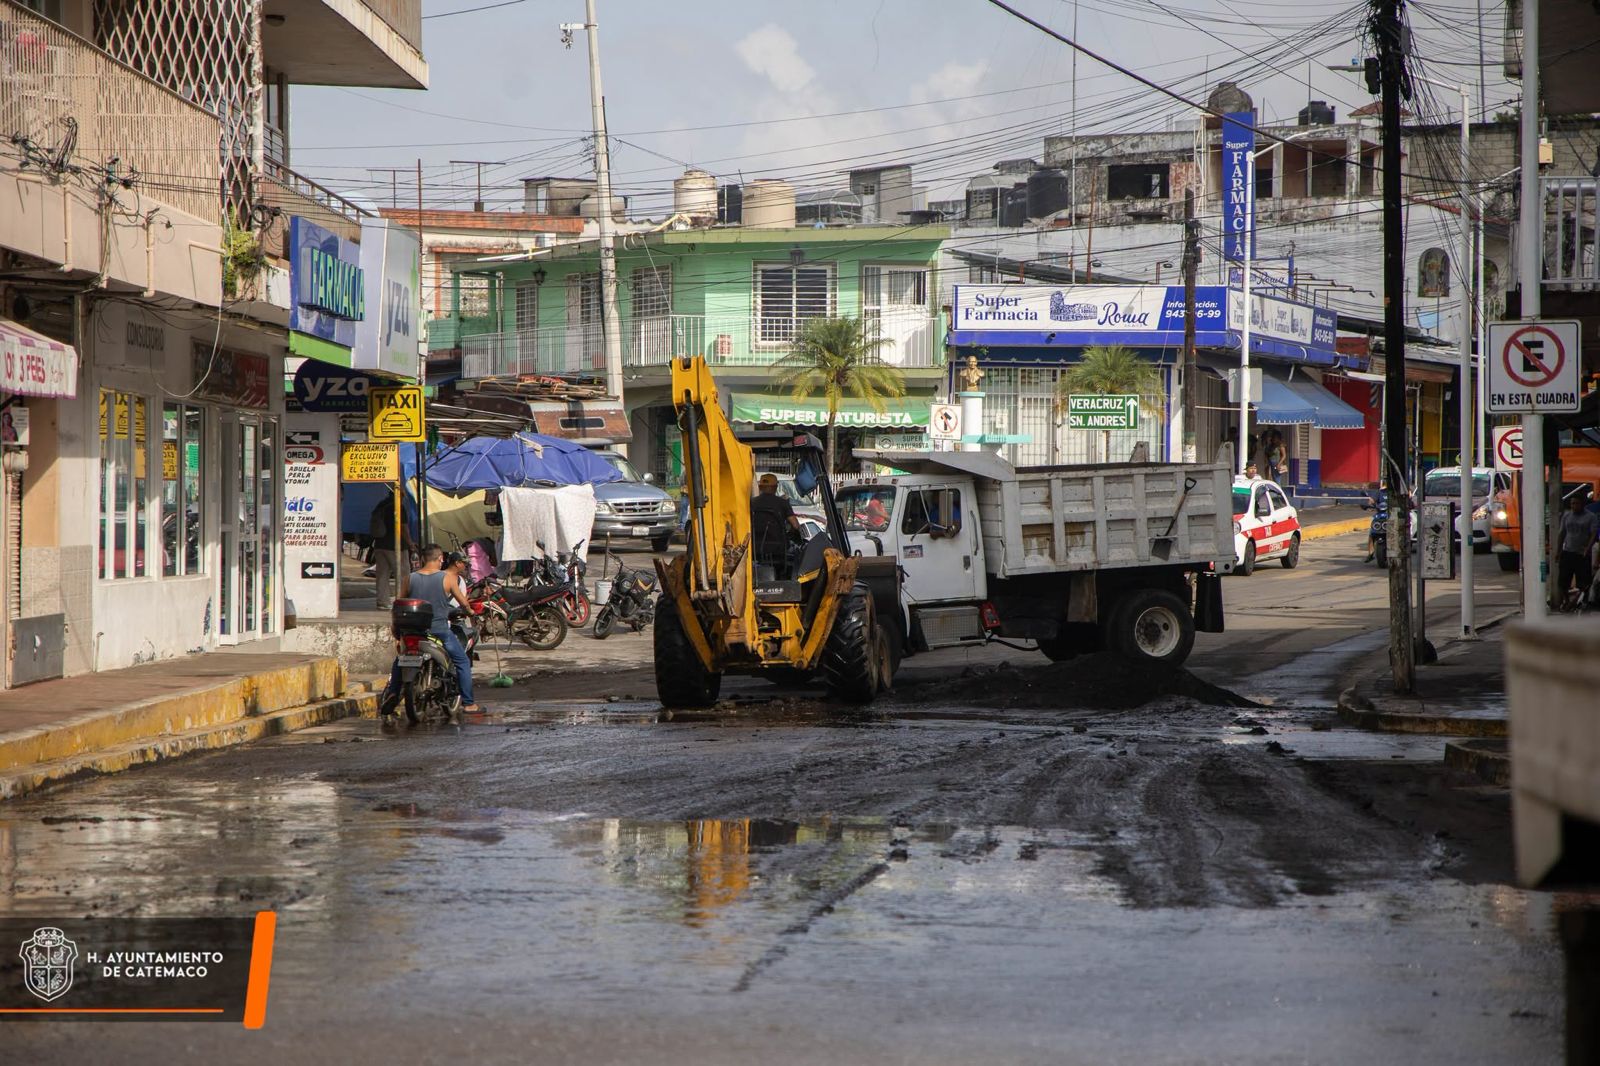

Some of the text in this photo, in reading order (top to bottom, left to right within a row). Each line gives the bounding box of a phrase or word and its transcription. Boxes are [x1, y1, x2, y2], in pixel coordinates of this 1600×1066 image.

[1226, 141, 1249, 149] Super
[1230, 151, 1245, 257] FARMACIA
[311, 248, 366, 322] FARMACIA
[975, 293, 1022, 310] Super
[1167, 300, 1218, 309] Inforación:
[386, 279, 410, 347] yza
[965, 307, 1038, 321] Farmacia
[1165, 310, 1221, 319] 9436-99
[302, 377, 370, 401] yza
[375, 393, 417, 409] TAXI
[1070, 398, 1123, 410] VERACRUZ
[1491, 393, 1576, 405] EN ESTA CUADRA
[760, 408, 913, 424] SUPER NATURISTA
[1070, 415, 1126, 426] SN. ANDRES
[286, 451, 315, 459] OMEGA
